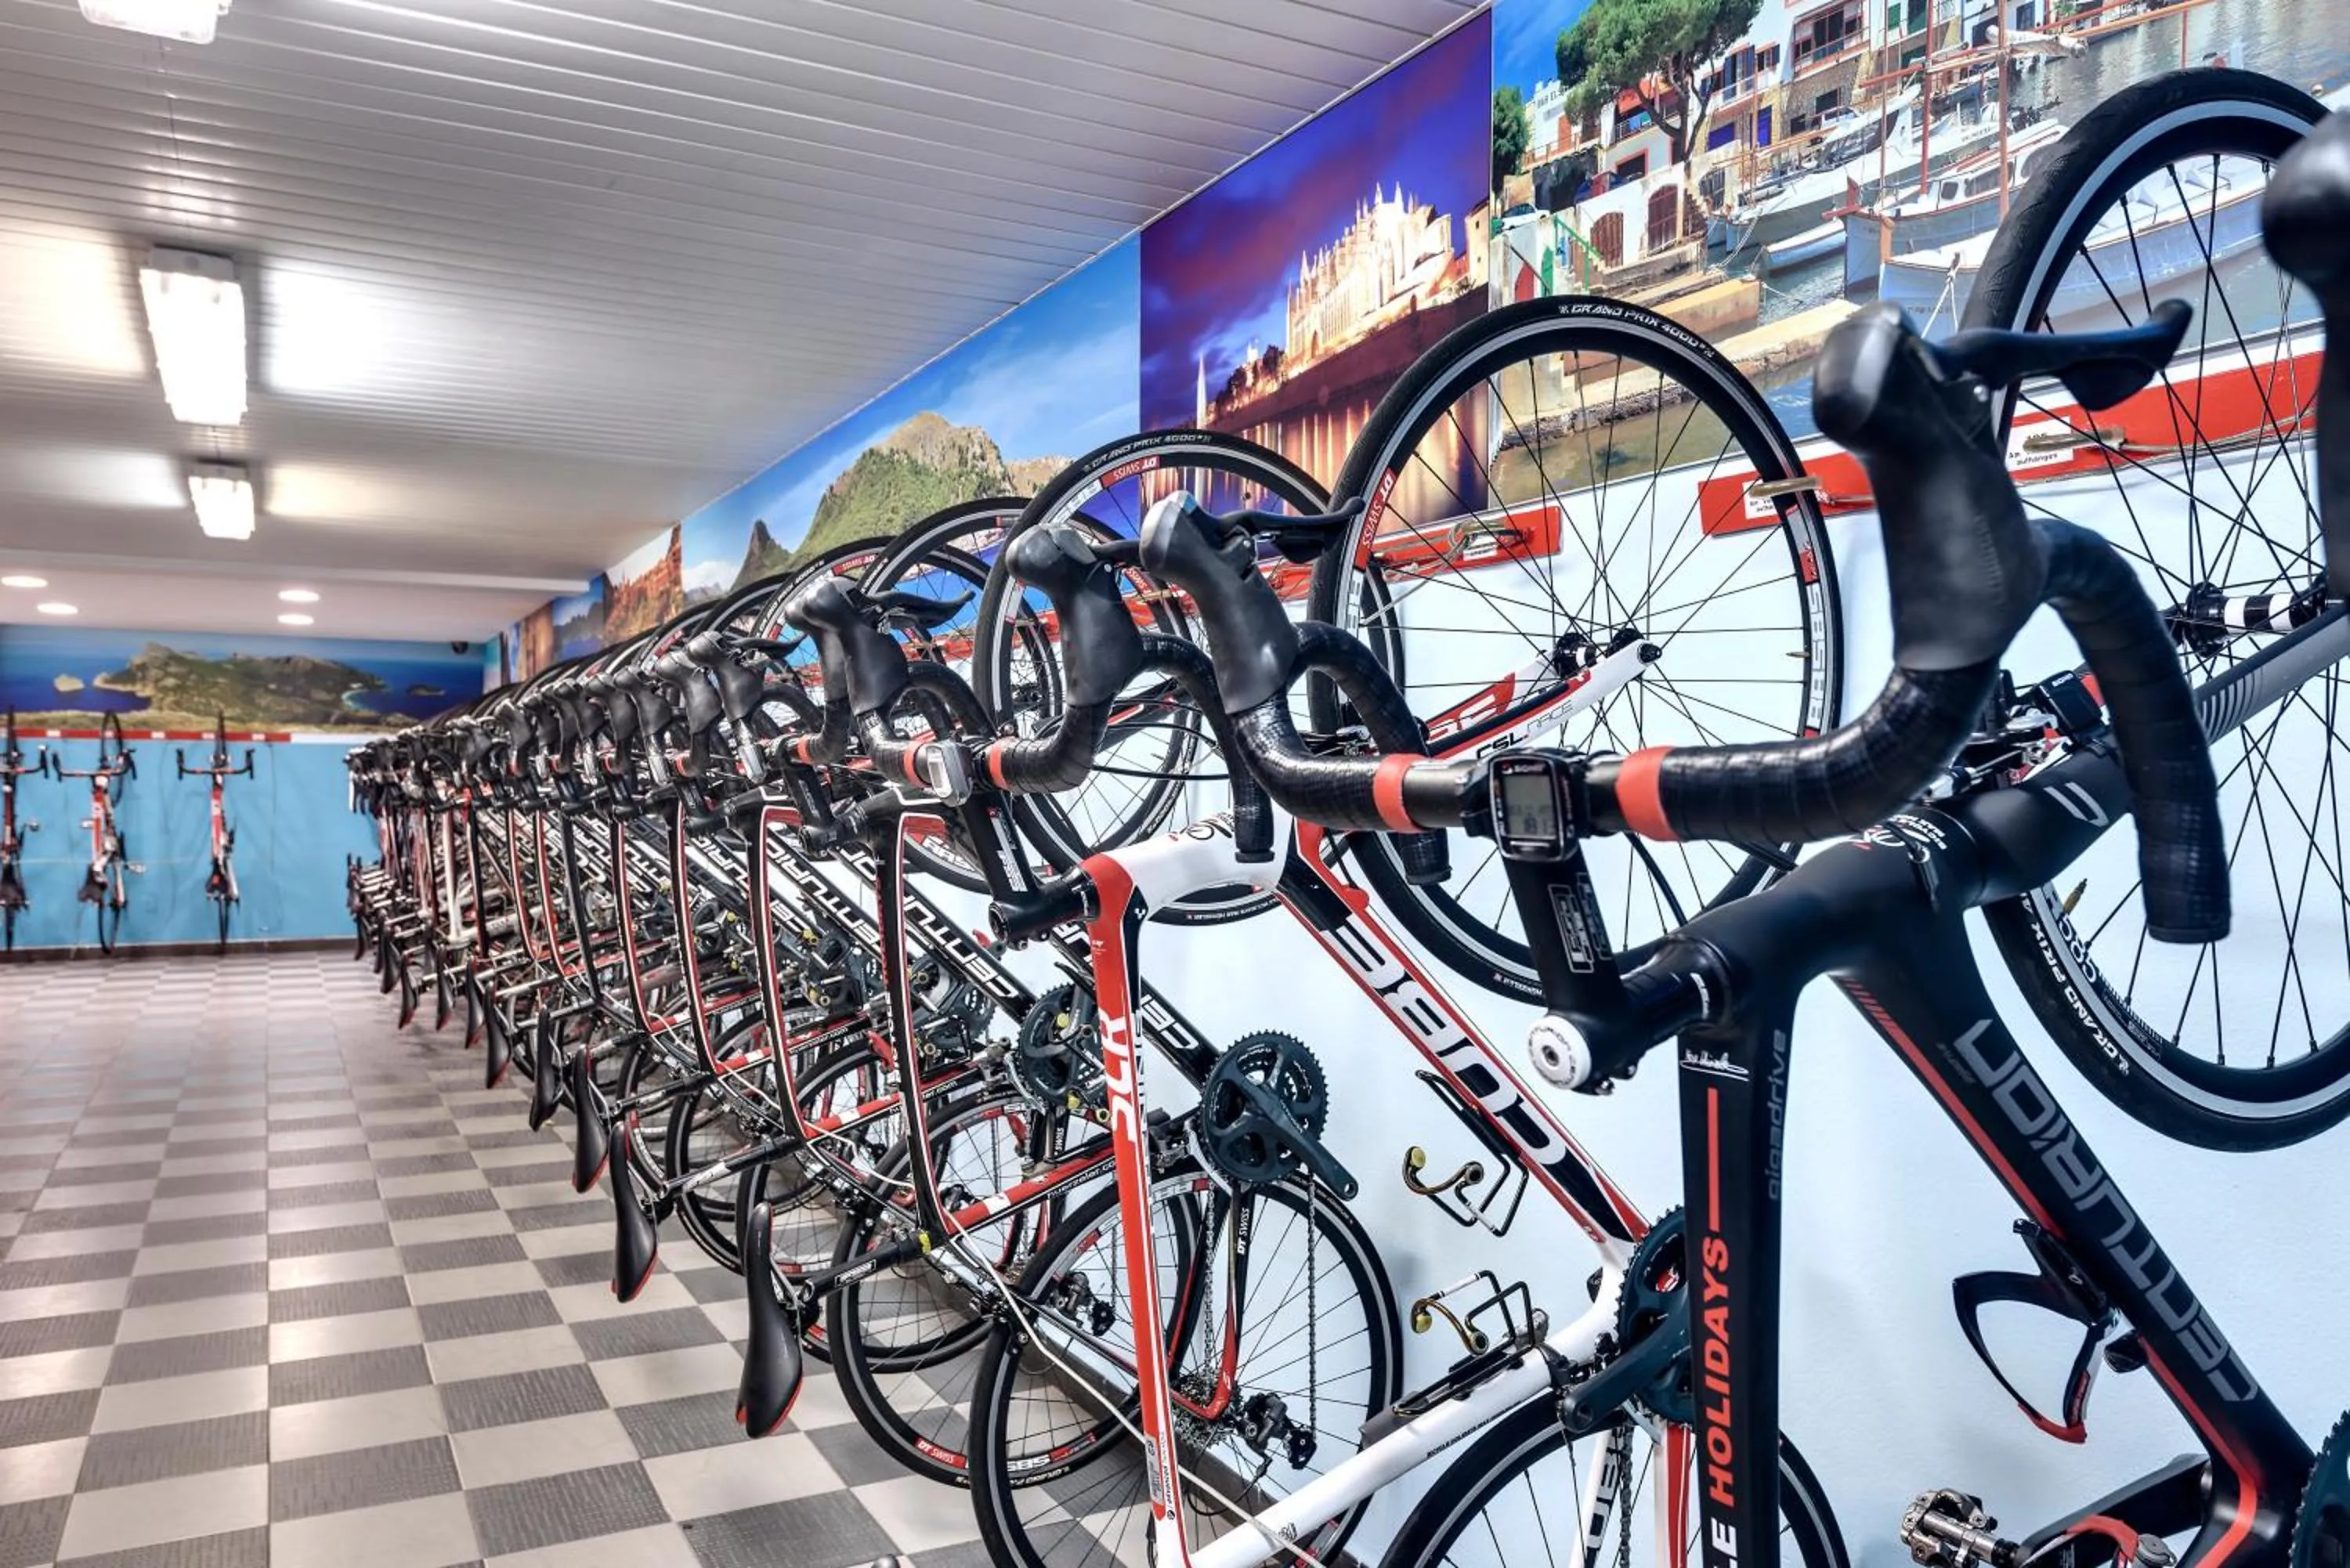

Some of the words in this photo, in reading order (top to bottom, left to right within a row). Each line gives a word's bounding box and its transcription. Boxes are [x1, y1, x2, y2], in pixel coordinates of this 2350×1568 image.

[1571, 303, 1623, 316] GRAND
[1625, 310, 1658, 327] PRIX
[1091, 443, 1132, 468] GRAND
[1133, 436, 1162, 449] PRIX
[1141, 457, 1157, 469] DT
[1112, 461, 1141, 480] SWISS
[1379, 473, 1394, 500] DT
[1362, 500, 1383, 548] SWISS
[2030, 921, 2066, 984] PRIX
[2063, 985, 2120, 1059] GRAND
[1330, 912, 1568, 1167] CUBE
[1767, 1022, 1787, 1200] gigadrive
[1238, 1207, 1251, 1237] SWISS
[1954, 1019, 2259, 1402] CENTURION
[1237, 1237, 1247, 1255] DT
[1701, 1235, 1736, 1508] HOLIDAYS
[917, 1440, 933, 1451] DT
[931, 1445, 954, 1464] SWISS
